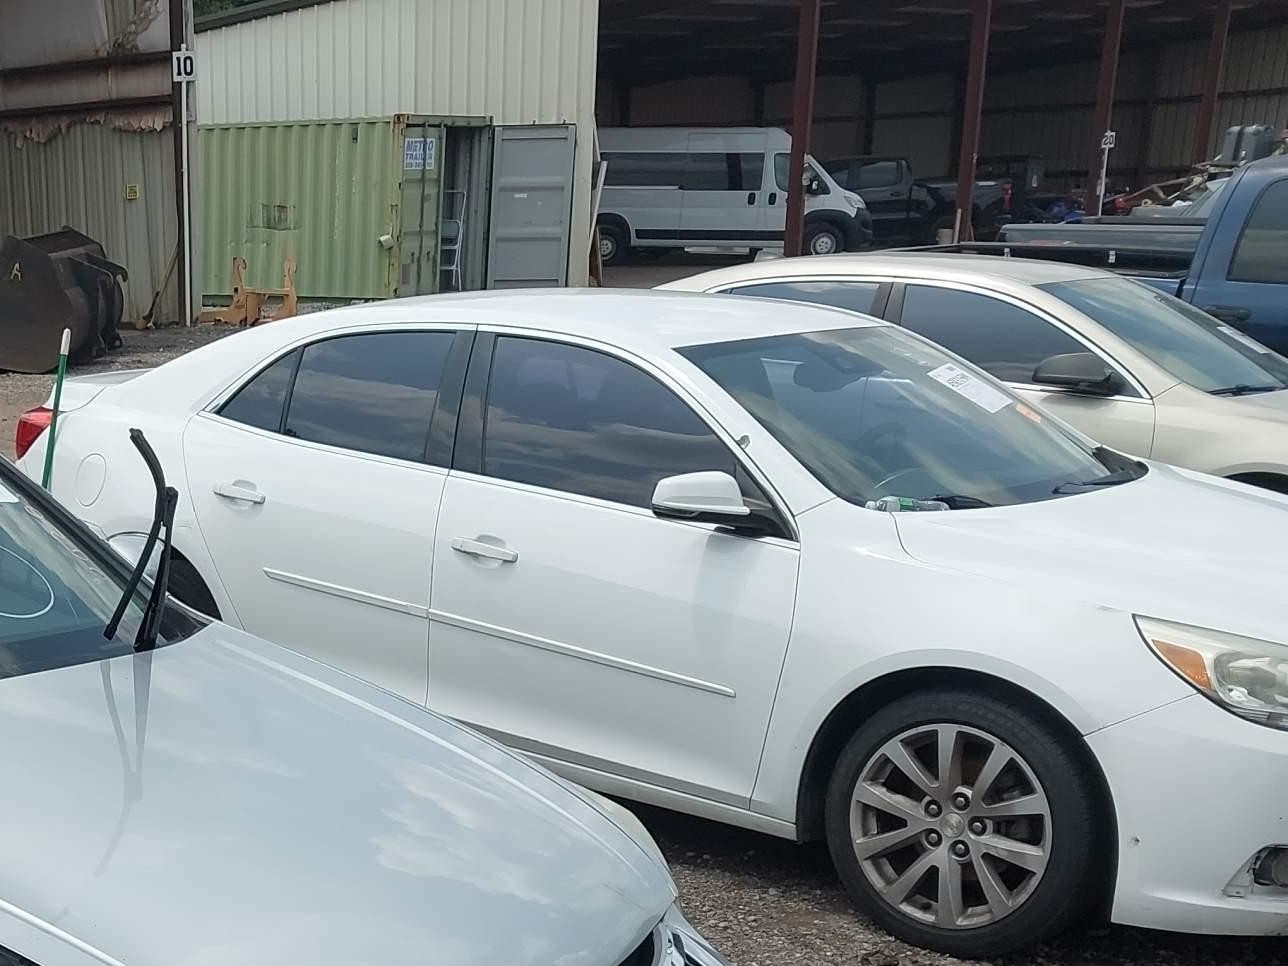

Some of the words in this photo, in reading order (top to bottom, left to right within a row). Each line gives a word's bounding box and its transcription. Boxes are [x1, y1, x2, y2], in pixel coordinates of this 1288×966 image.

[176, 56, 194, 76] 10
[1103, 134, 1113, 145] 20
[405, 152, 433, 161] TRAILR
